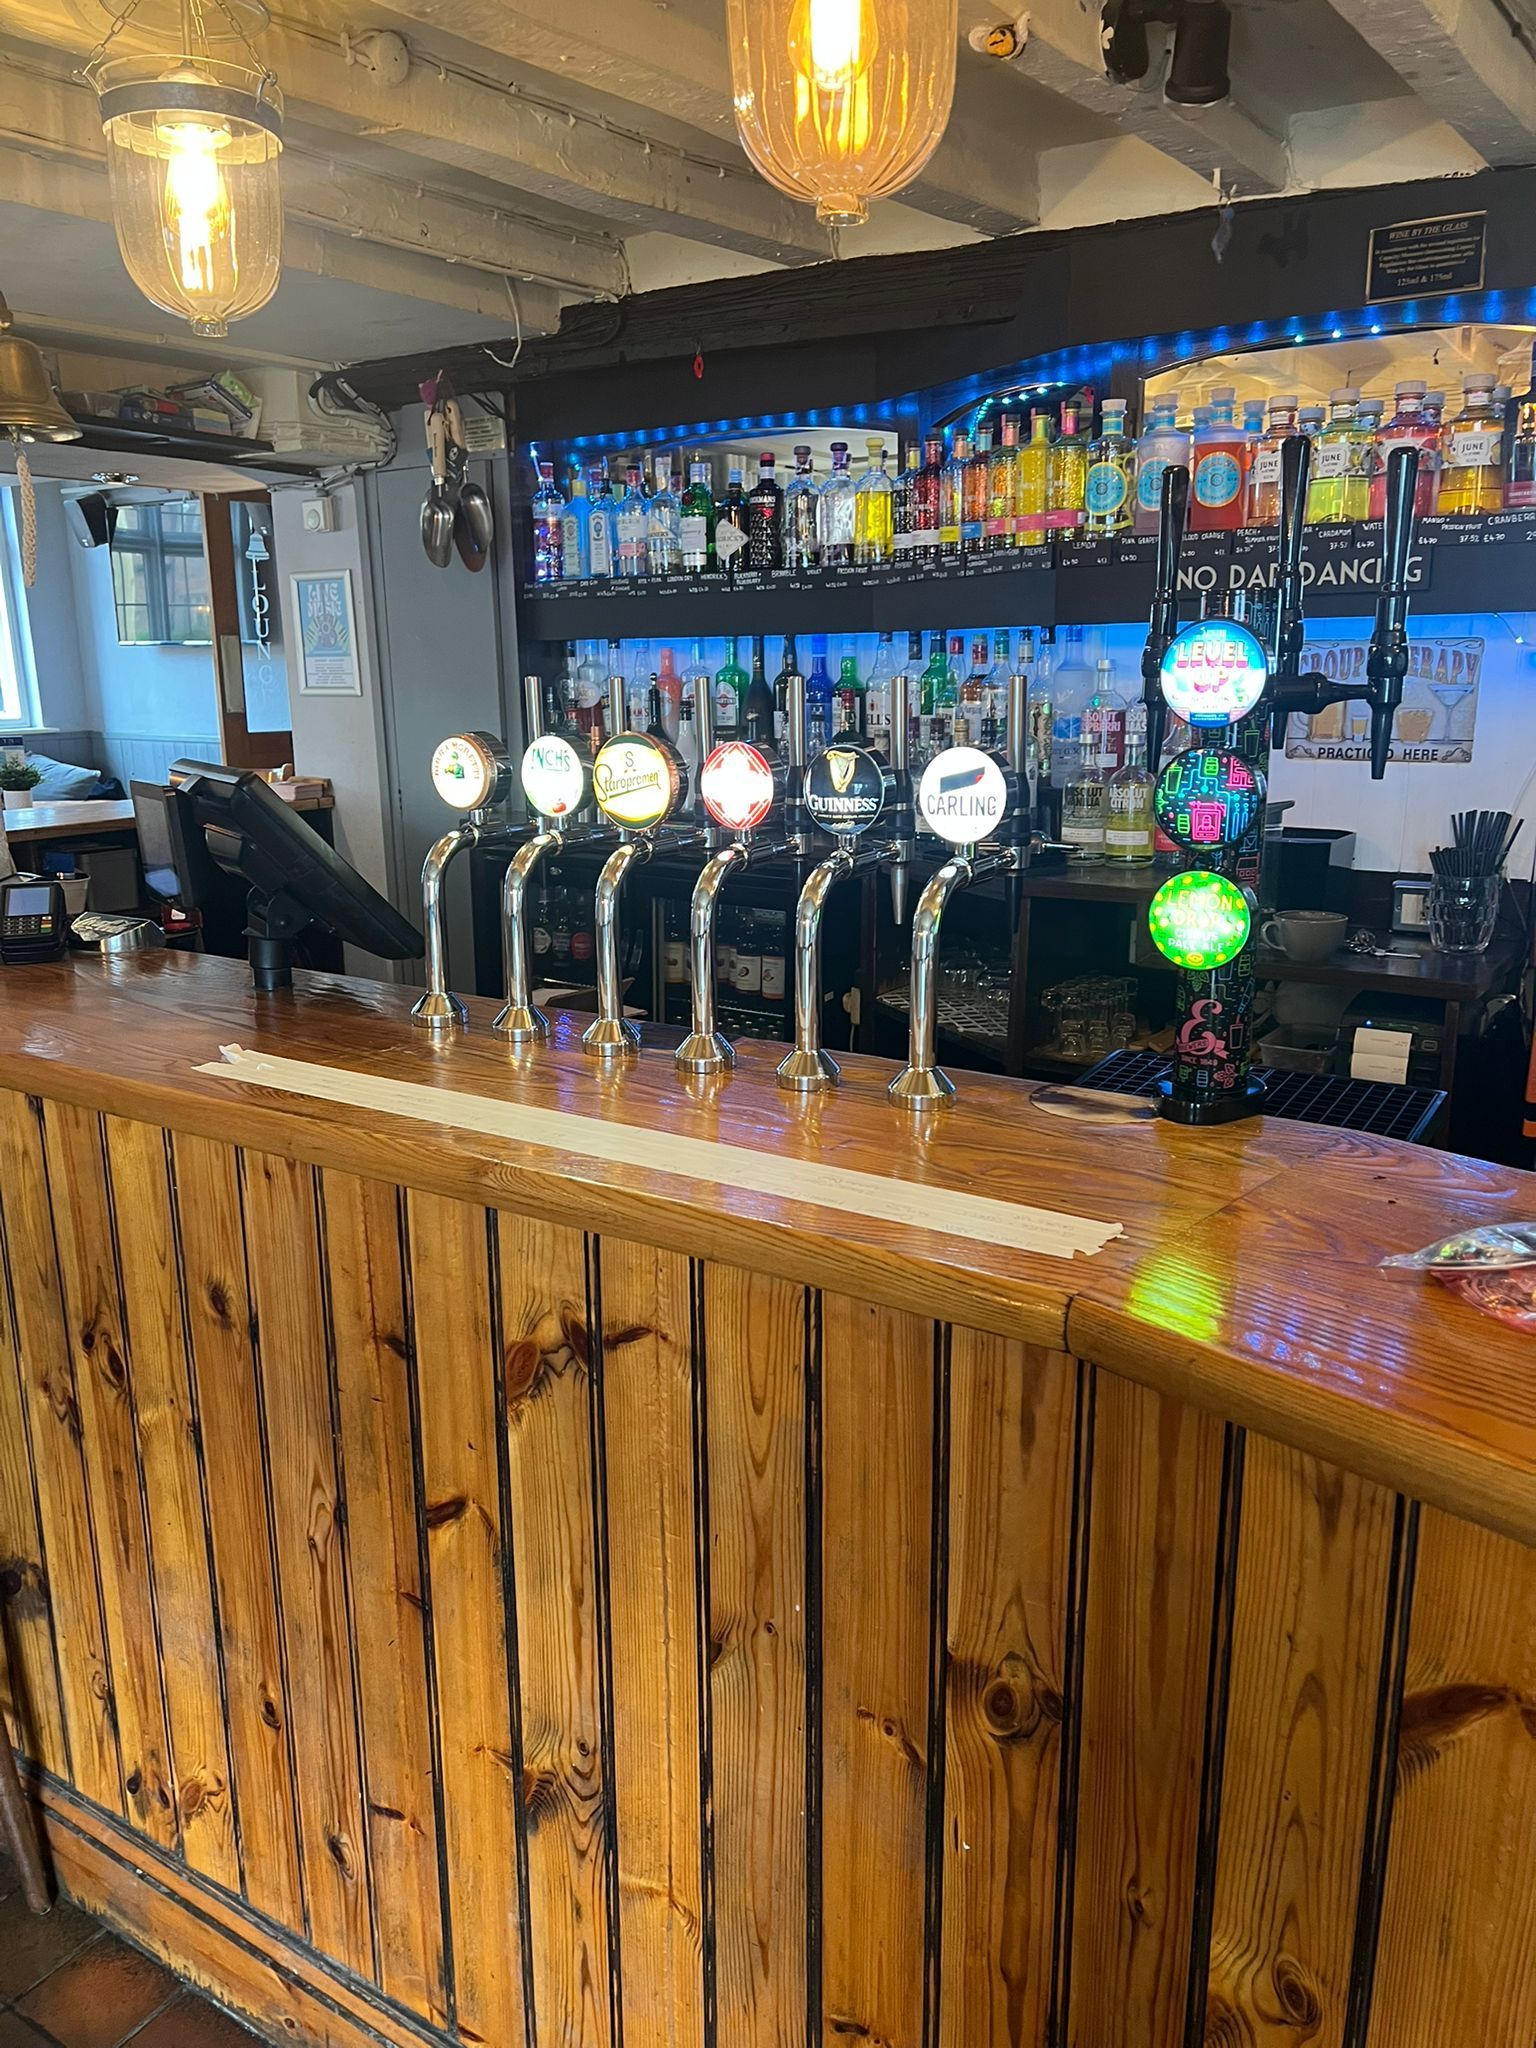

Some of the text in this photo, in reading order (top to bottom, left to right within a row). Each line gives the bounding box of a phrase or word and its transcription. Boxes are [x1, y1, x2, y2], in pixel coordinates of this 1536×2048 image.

[1461, 442, 1484, 453] JUNE
[1260, 459, 1279, 471] JUNE
[1321, 453, 1341, 464] JUNE
[1487, 512, 1536, 526] CRANBERR
[1072, 541, 1097, 550] LEMON
[1182, 533, 1199, 542] LOOD
[1177, 565, 1218, 592] NO
[1299, 556, 1422, 587] DANCIG
[307, 582, 339, 602] LIVE
[307, 601, 343, 618] MUSIC
[1176, 640, 1250, 668] LEVEL
[1409, 646, 1480, 684] ERAPY
[866, 713, 891, 725] ELL'S
[531, 747, 571, 773] INCH'S
[625, 750, 635, 768] S
[1318, 746, 1439, 761] PRACTICD HERE
[1109, 787, 1149, 798] ABSOLUT
[809, 794, 879, 813] GUINNESS
[927, 794, 997, 818] CARLING
[1167, 890, 1233, 912] LEMON
[1202, 942, 1224, 952] ALE
